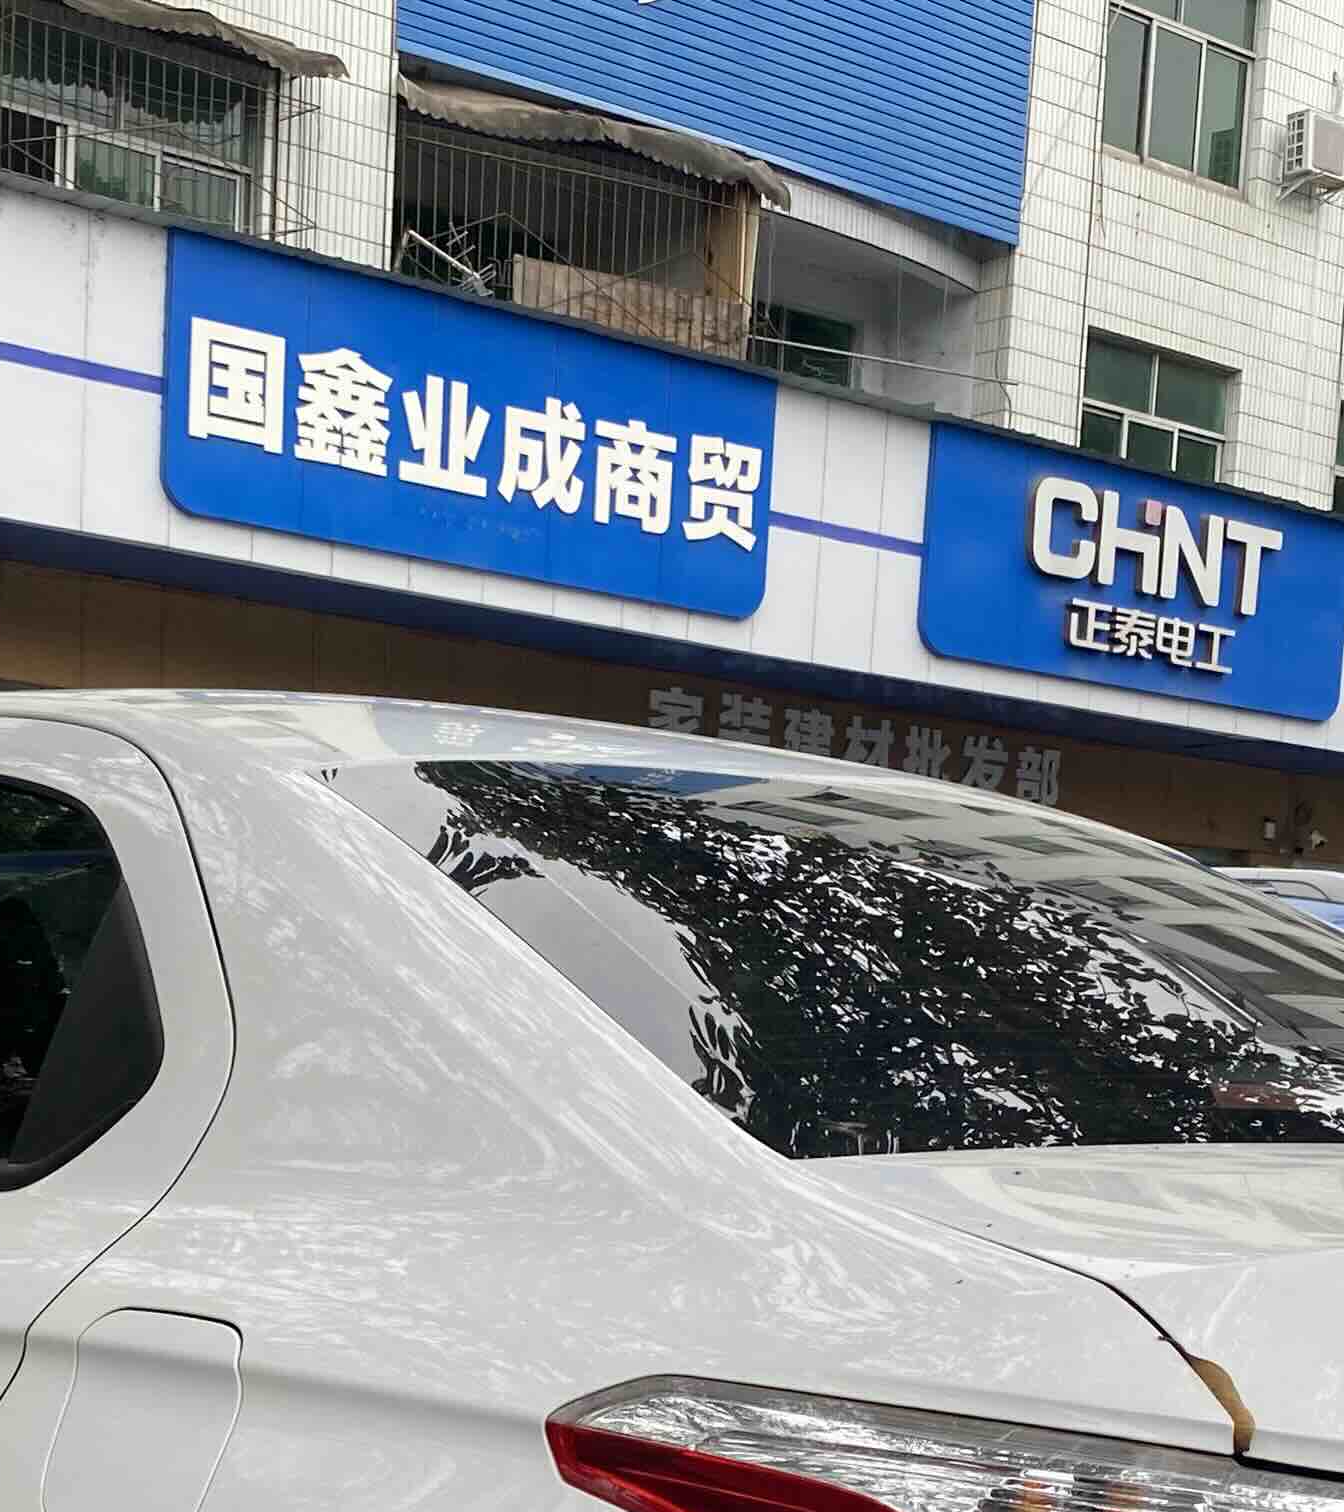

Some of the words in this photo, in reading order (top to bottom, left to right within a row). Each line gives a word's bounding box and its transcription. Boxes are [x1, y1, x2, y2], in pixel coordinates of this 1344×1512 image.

[187, 316, 762, 552] 国鑫业成商贸
[1068, 597, 1237, 674] 正泰电工
